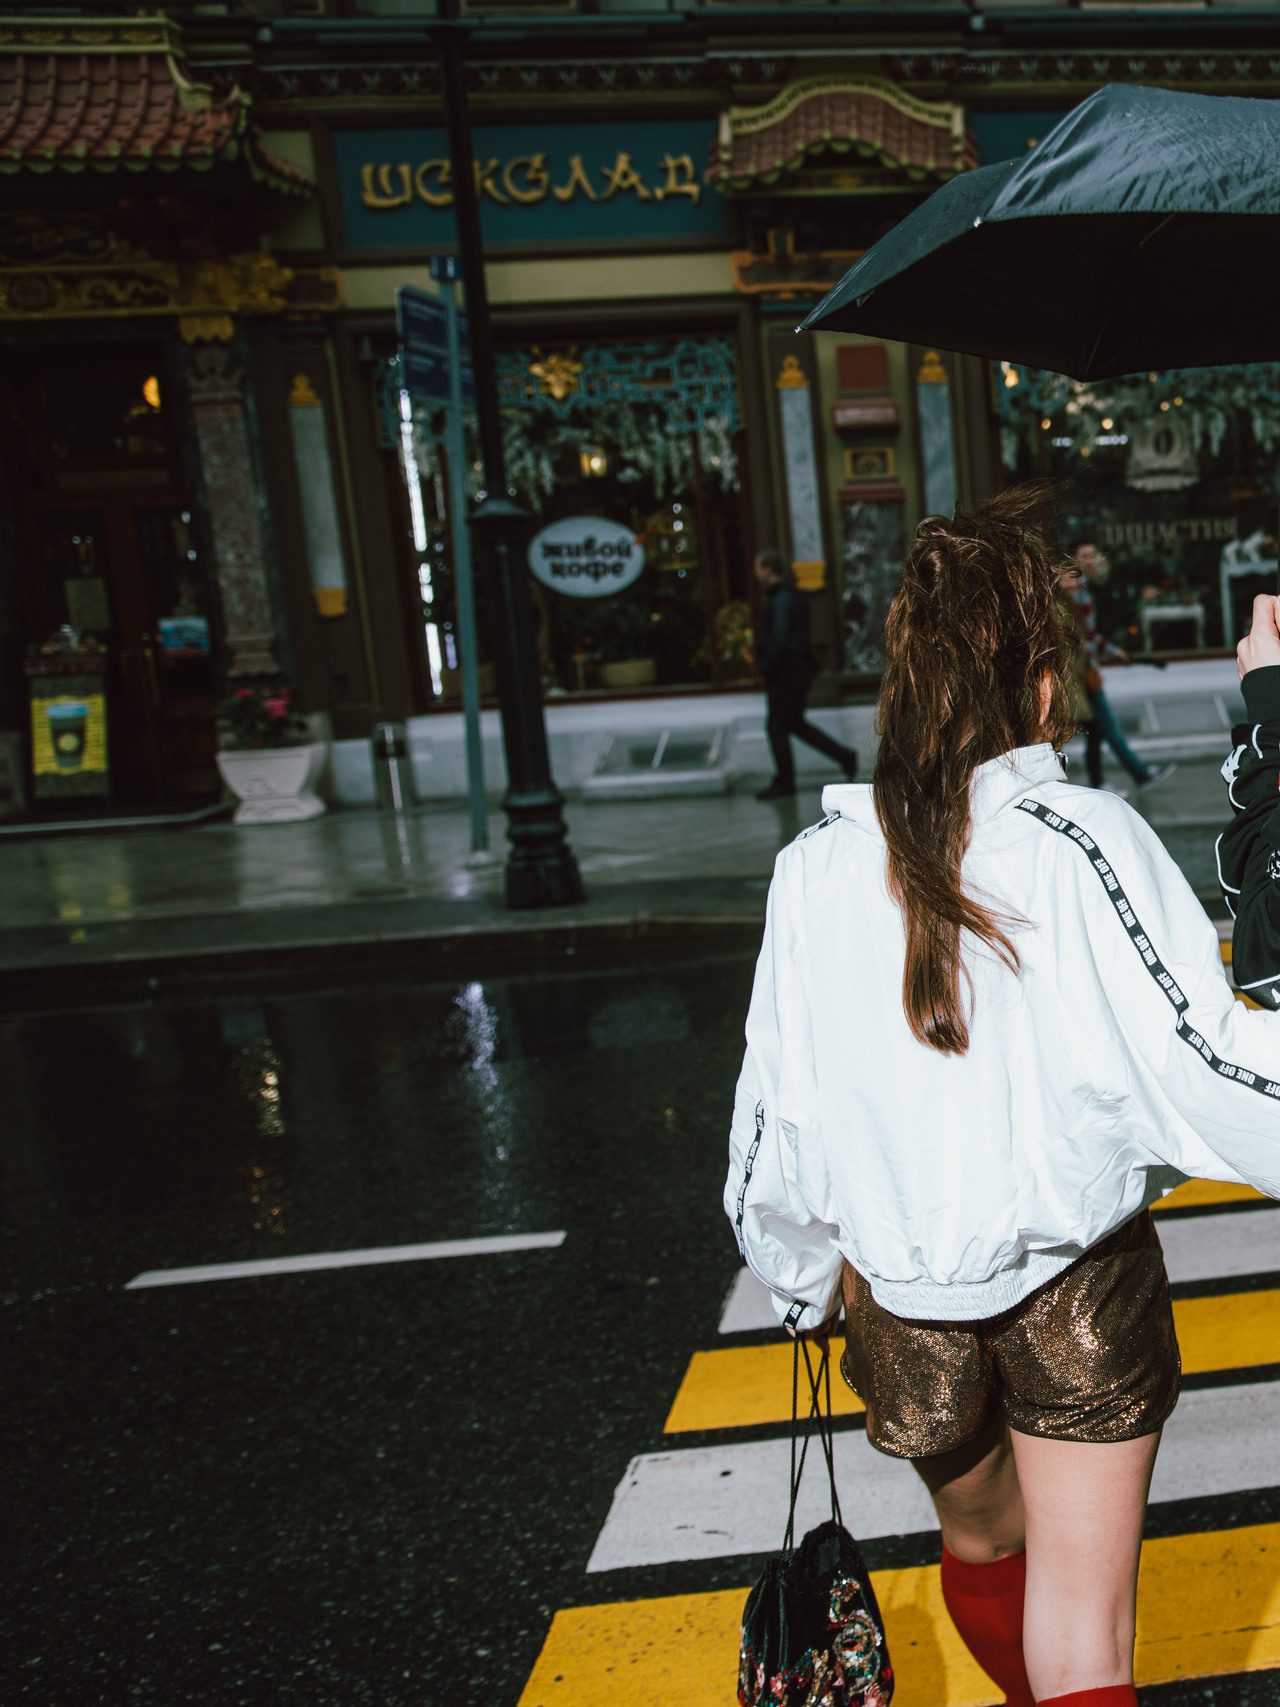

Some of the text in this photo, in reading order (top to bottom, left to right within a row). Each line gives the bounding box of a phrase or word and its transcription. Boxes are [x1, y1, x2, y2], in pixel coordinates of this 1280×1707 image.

[1067, 826, 1096, 851] ONE OFF
[1093, 858, 1119, 892] ONE OFF
[1116, 898, 1137, 928] ONE OFF
[1133, 934, 1158, 966] ONE OFF
[1156, 971, 1185, 1005] ONE OFF
[1187, 1031, 1213, 1062] ONE OFF
[1217, 1062, 1256, 1085] ONE OFF
